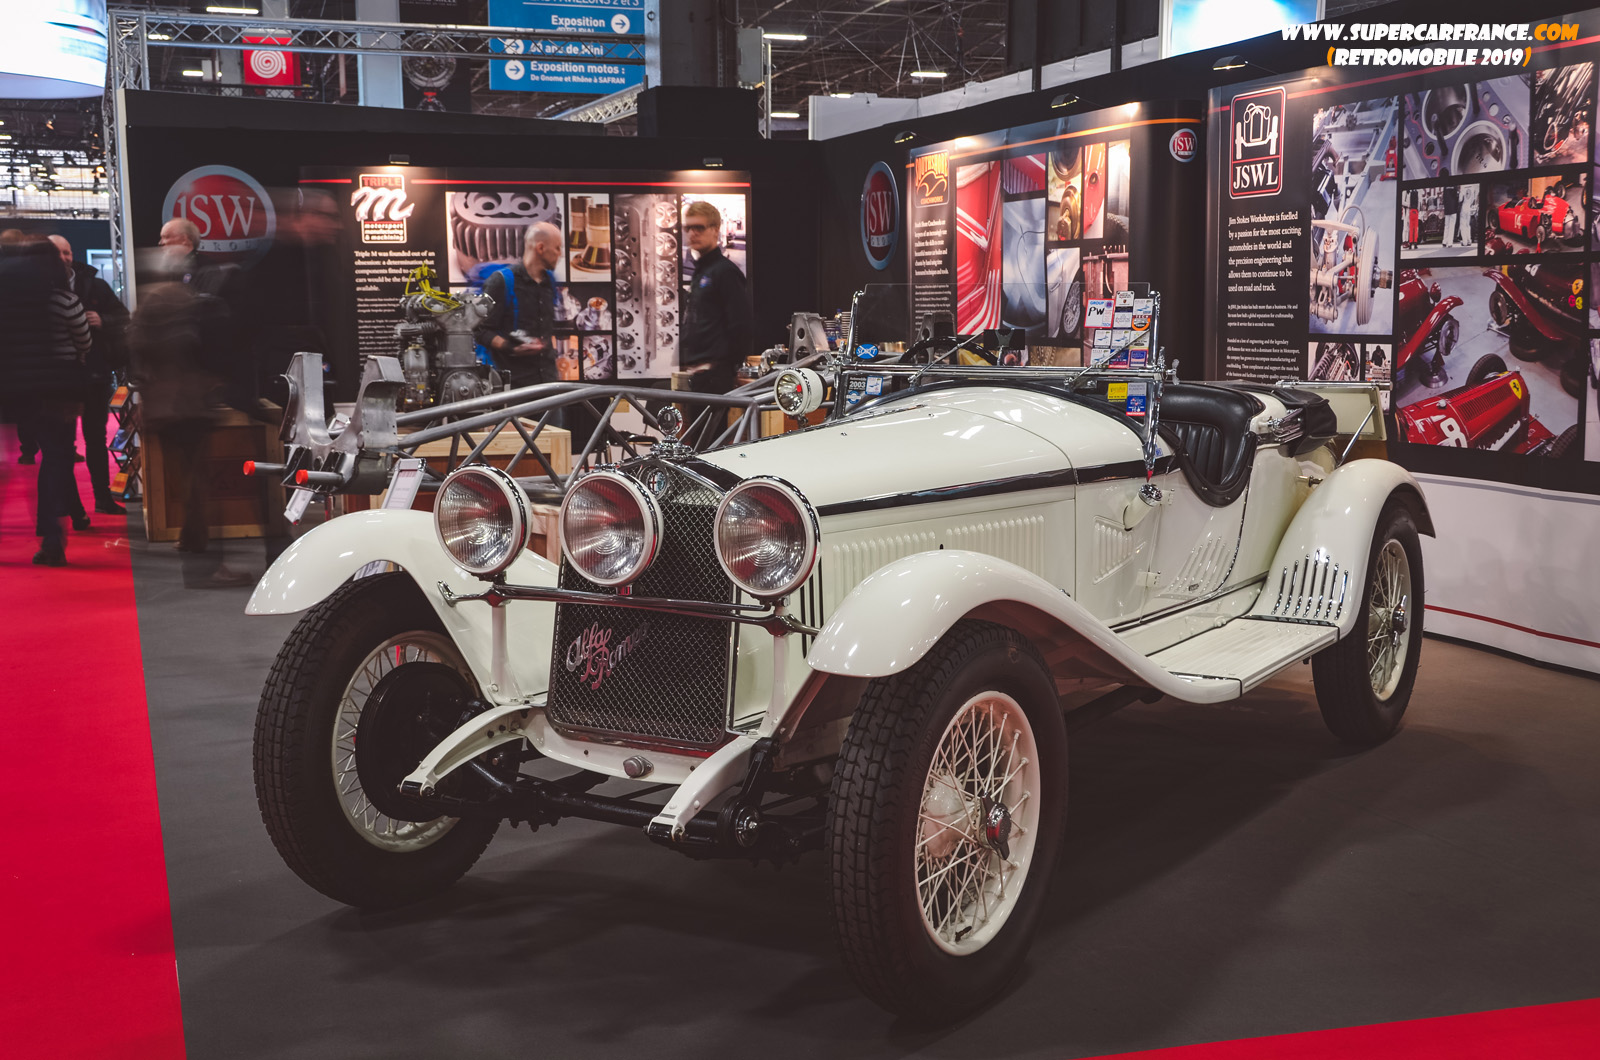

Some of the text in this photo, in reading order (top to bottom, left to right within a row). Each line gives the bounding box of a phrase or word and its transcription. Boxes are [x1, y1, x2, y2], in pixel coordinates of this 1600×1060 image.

[551, 15, 606, 30] Exposition
[566, 44, 579, 54] de
[581, 45, 604, 56] Mini
[530, 61, 585, 75] Exposition
[587, 64, 619, 75] motos
[572, 75, 592, 83] Rhône
[1174, 137, 1194, 153] JSW
[362, 177, 401, 187] TRIPLE
[1233, 162, 1279, 189] JSWL
[865, 191, 892, 242] JSW
[1250, 213, 1275, 224] Workshops
[1276, 213, 1280, 221] is
[1281, 211, 1298, 220] fuelled
[1514, 213, 1522, 229] 14
[1258, 241, 1266, 250] the
[1267, 240, 1281, 249] world
[1282, 240, 1292, 249] and
[354, 250, 370, 258] Triple
[1285, 268, 1292, 277] be
